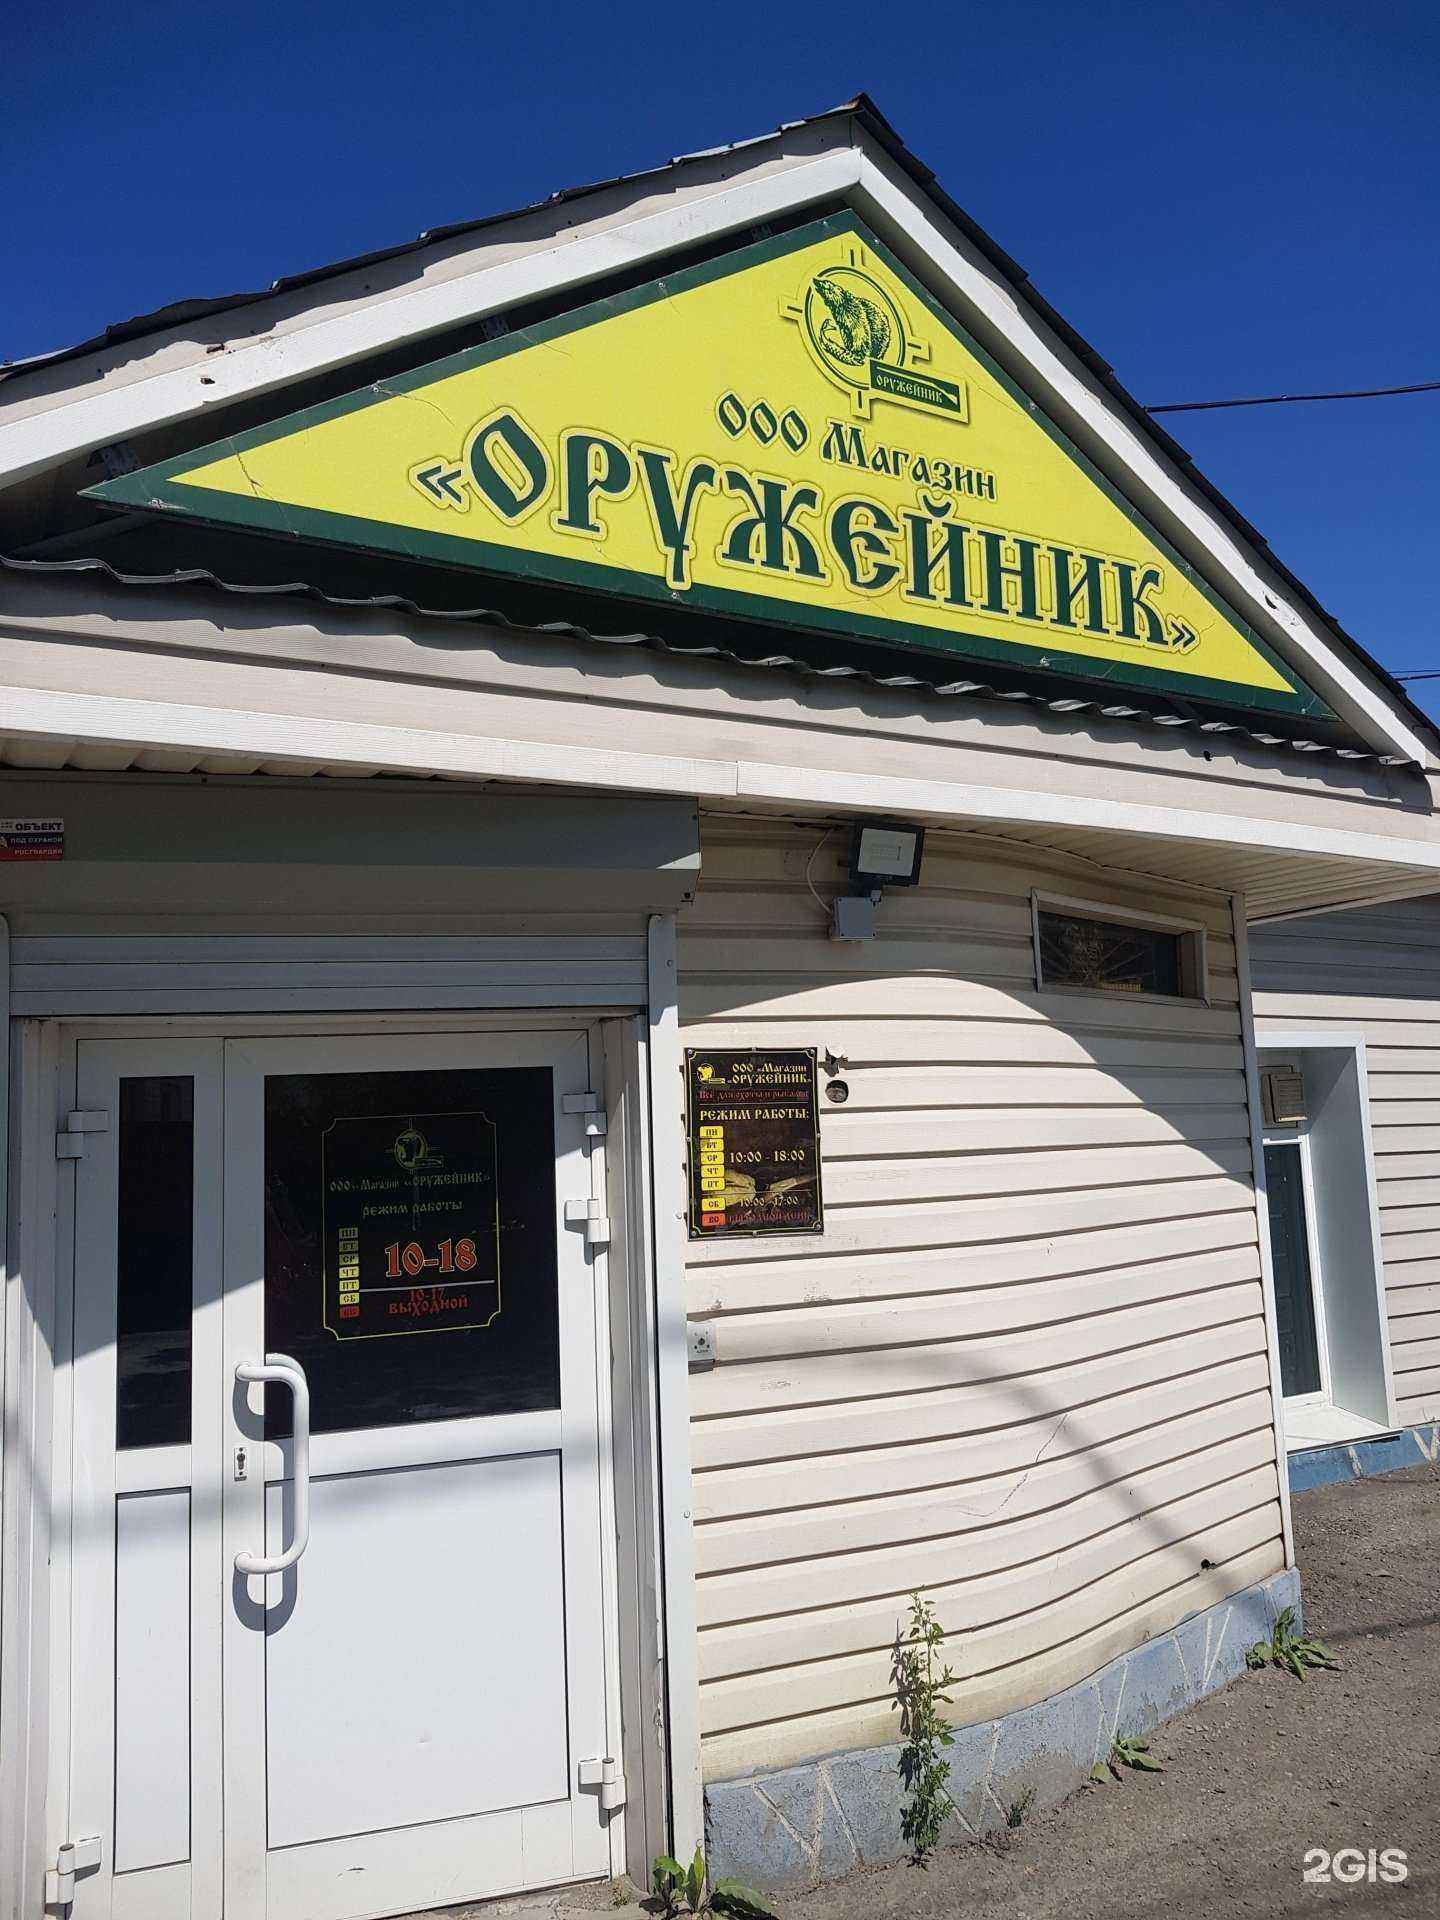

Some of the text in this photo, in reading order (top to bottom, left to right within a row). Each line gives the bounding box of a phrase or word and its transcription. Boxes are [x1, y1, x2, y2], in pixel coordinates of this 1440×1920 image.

[876, 374, 943, 404] ОРУЖЕЙНИК
[718, 393, 996, 501] ООО Магазин
[413, 408, 1198, 653] «ОРУЖЕЙНИК»
[15, 822, 62, 831] ОБЪЕКТ
[732, 1063, 754, 1073] ООО
[705, 1128, 718, 1136] ПН
[730, 1151, 762, 1163] 10:00
[773, 1149, 805, 1162] 18:00
[707, 1167, 719, 1175] ЧТ
[707, 1180, 719, 1188] ПТ
[740, 1197, 765, 1208] 10:00
[385, 1237, 477, 1278] 10-18
